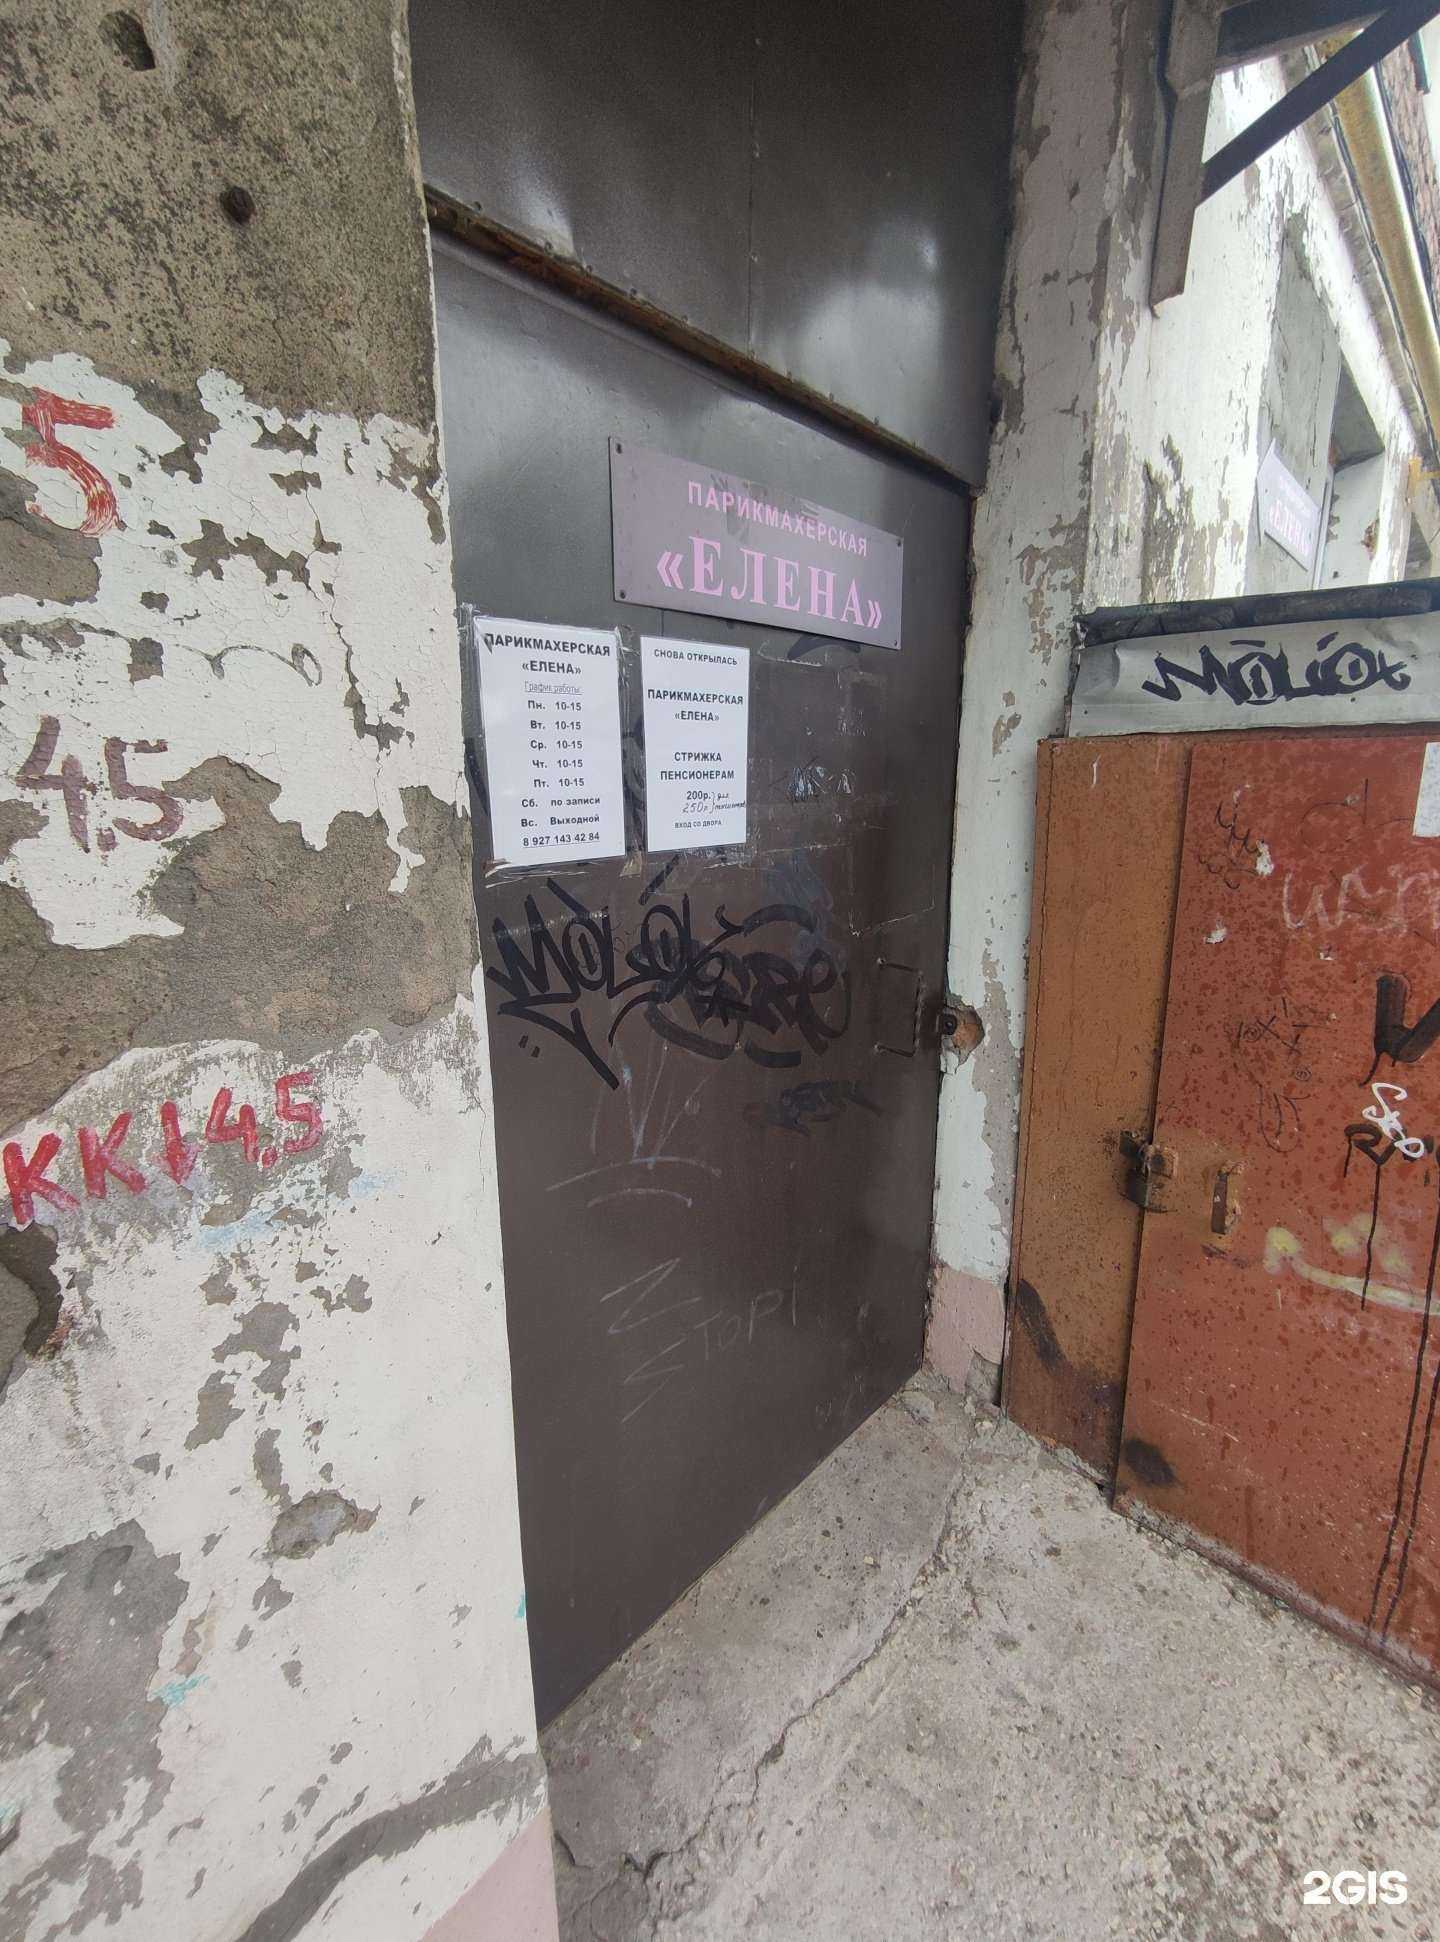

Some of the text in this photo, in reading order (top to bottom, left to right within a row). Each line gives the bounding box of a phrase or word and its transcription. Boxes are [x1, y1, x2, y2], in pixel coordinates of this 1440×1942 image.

[688, 480, 868, 557] ПАРИКМАХЕРСКАЯ
[656, 535, 883, 629] «ЕЛЕНА»
[654, 648, 738, 666] СНОВА ОТКРЫЛАСЬ
[522, 660, 582, 675] «ЕЛЕНА»
[647, 689, 744, 705] ПАРИКМАХЕРСКАЯ
[527, 700, 582, 711] Пн. 10-15
[674, 710, 720, 722] «ЕЛЕНА»
[530, 719, 582, 730] Вт. 10-15
[530, 739, 583, 751] Ср. 10-15
[674, 751, 722, 762] СТРИЖКА
[532, 759, 583, 769] Чт. 10-15
[660, 770, 735, 781] ПЕНСИОНЕРАМ
[533, 777, 585, 788] Пт. 10-15
[686, 790, 711, 801] 200р.
[521, 797, 600, 808] Сб. по записи
[520, 813, 600, 828] Вс. Выходной
[522, 831, 600, 847] 8 927 143 42 84
